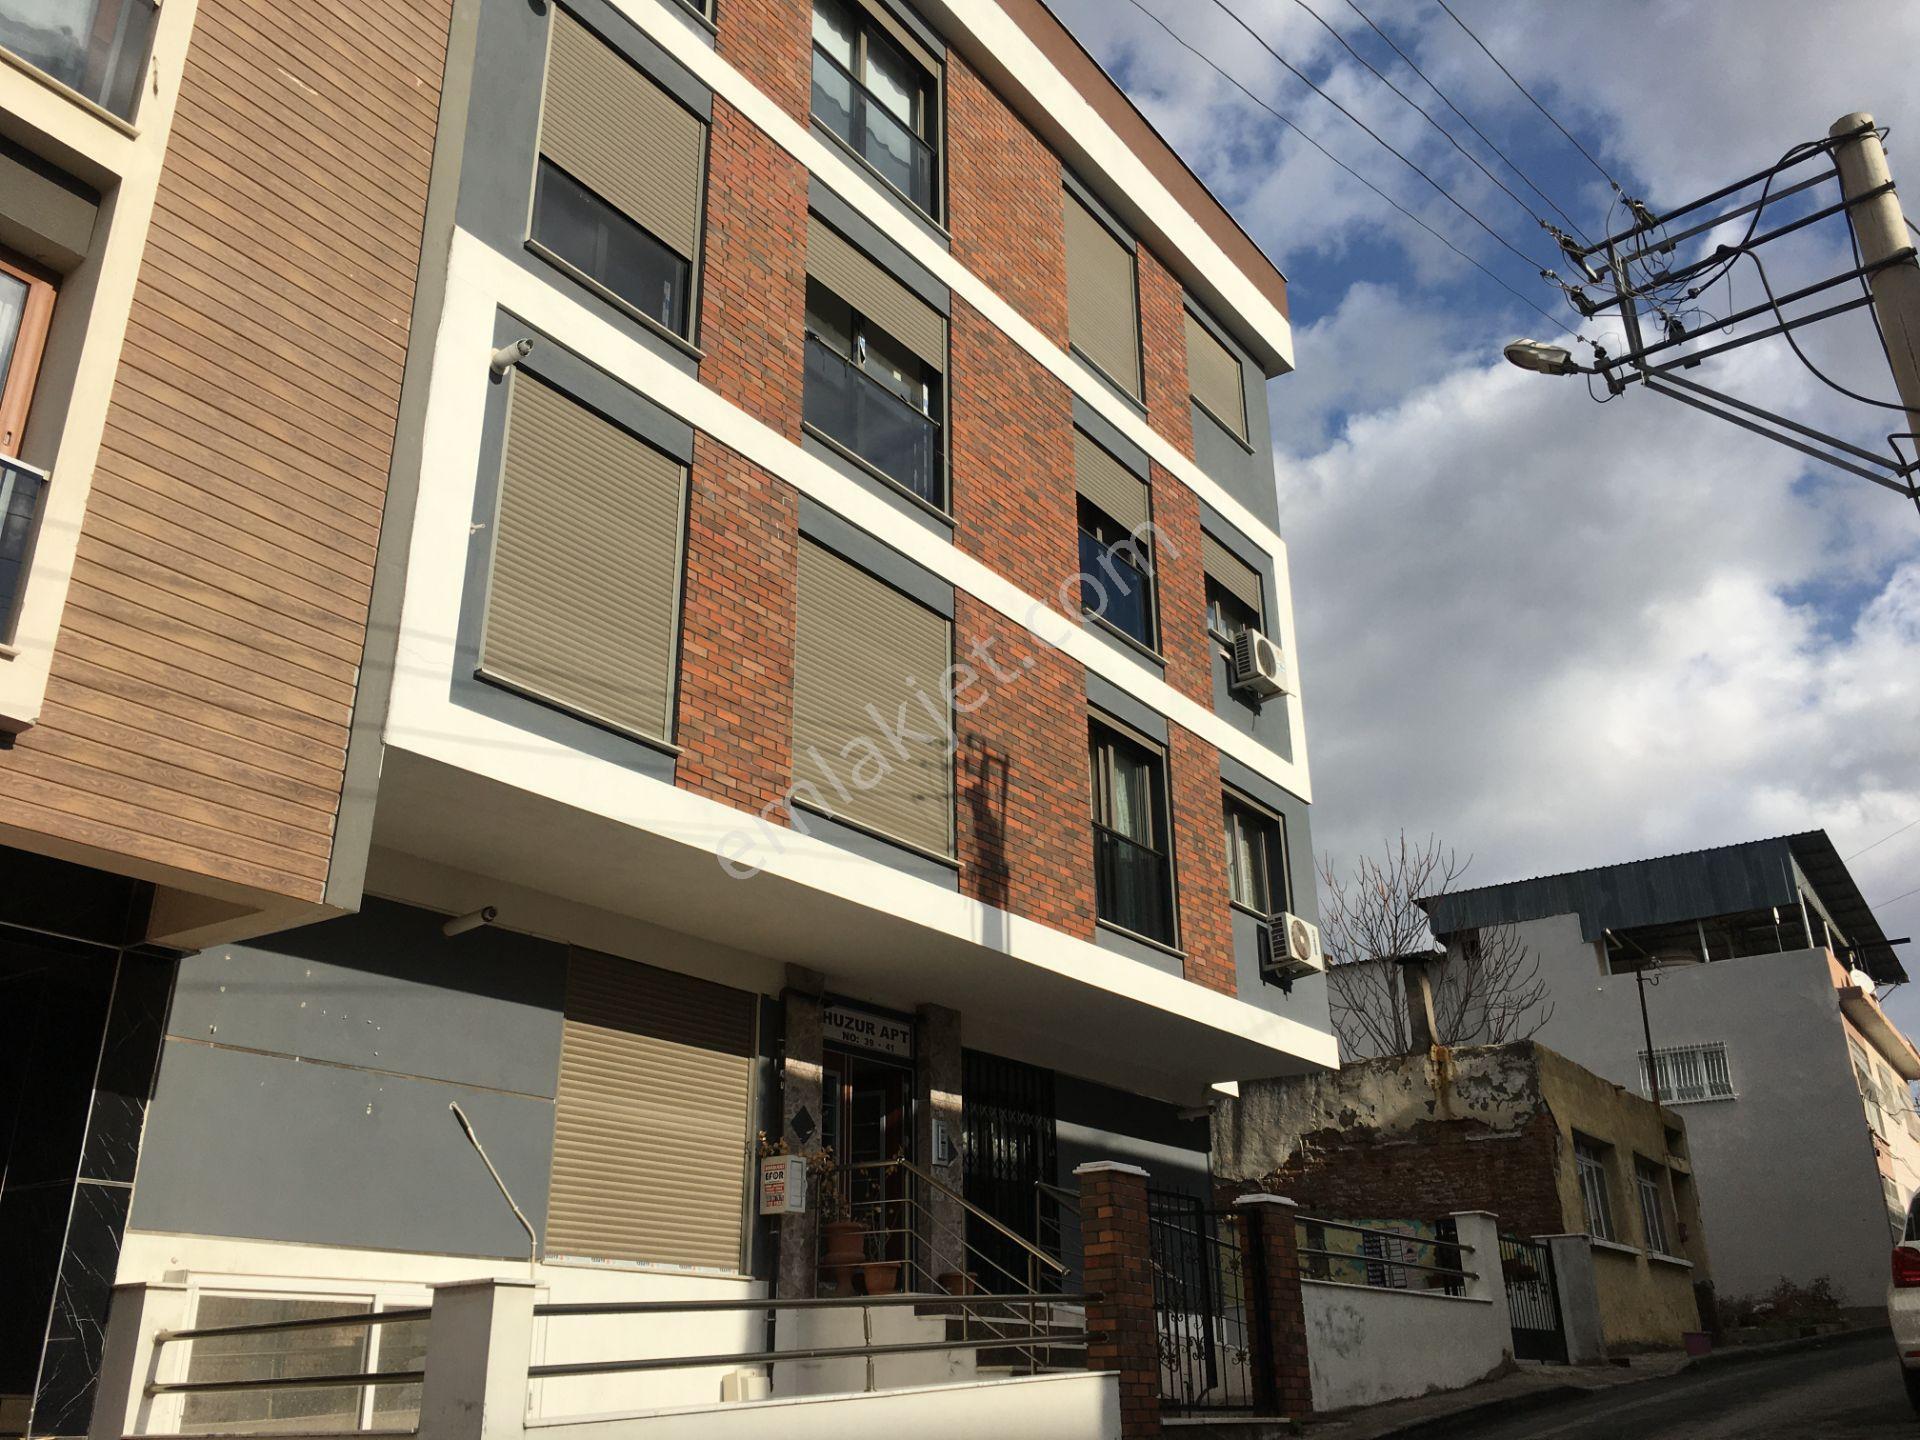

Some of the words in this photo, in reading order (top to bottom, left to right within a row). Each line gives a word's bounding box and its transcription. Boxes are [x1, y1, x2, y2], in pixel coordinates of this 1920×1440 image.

[823, 1010, 875, 1035] HUZUR
[880, 1025, 909, 1043] APT
[842, 1032, 859, 1043] NO:
